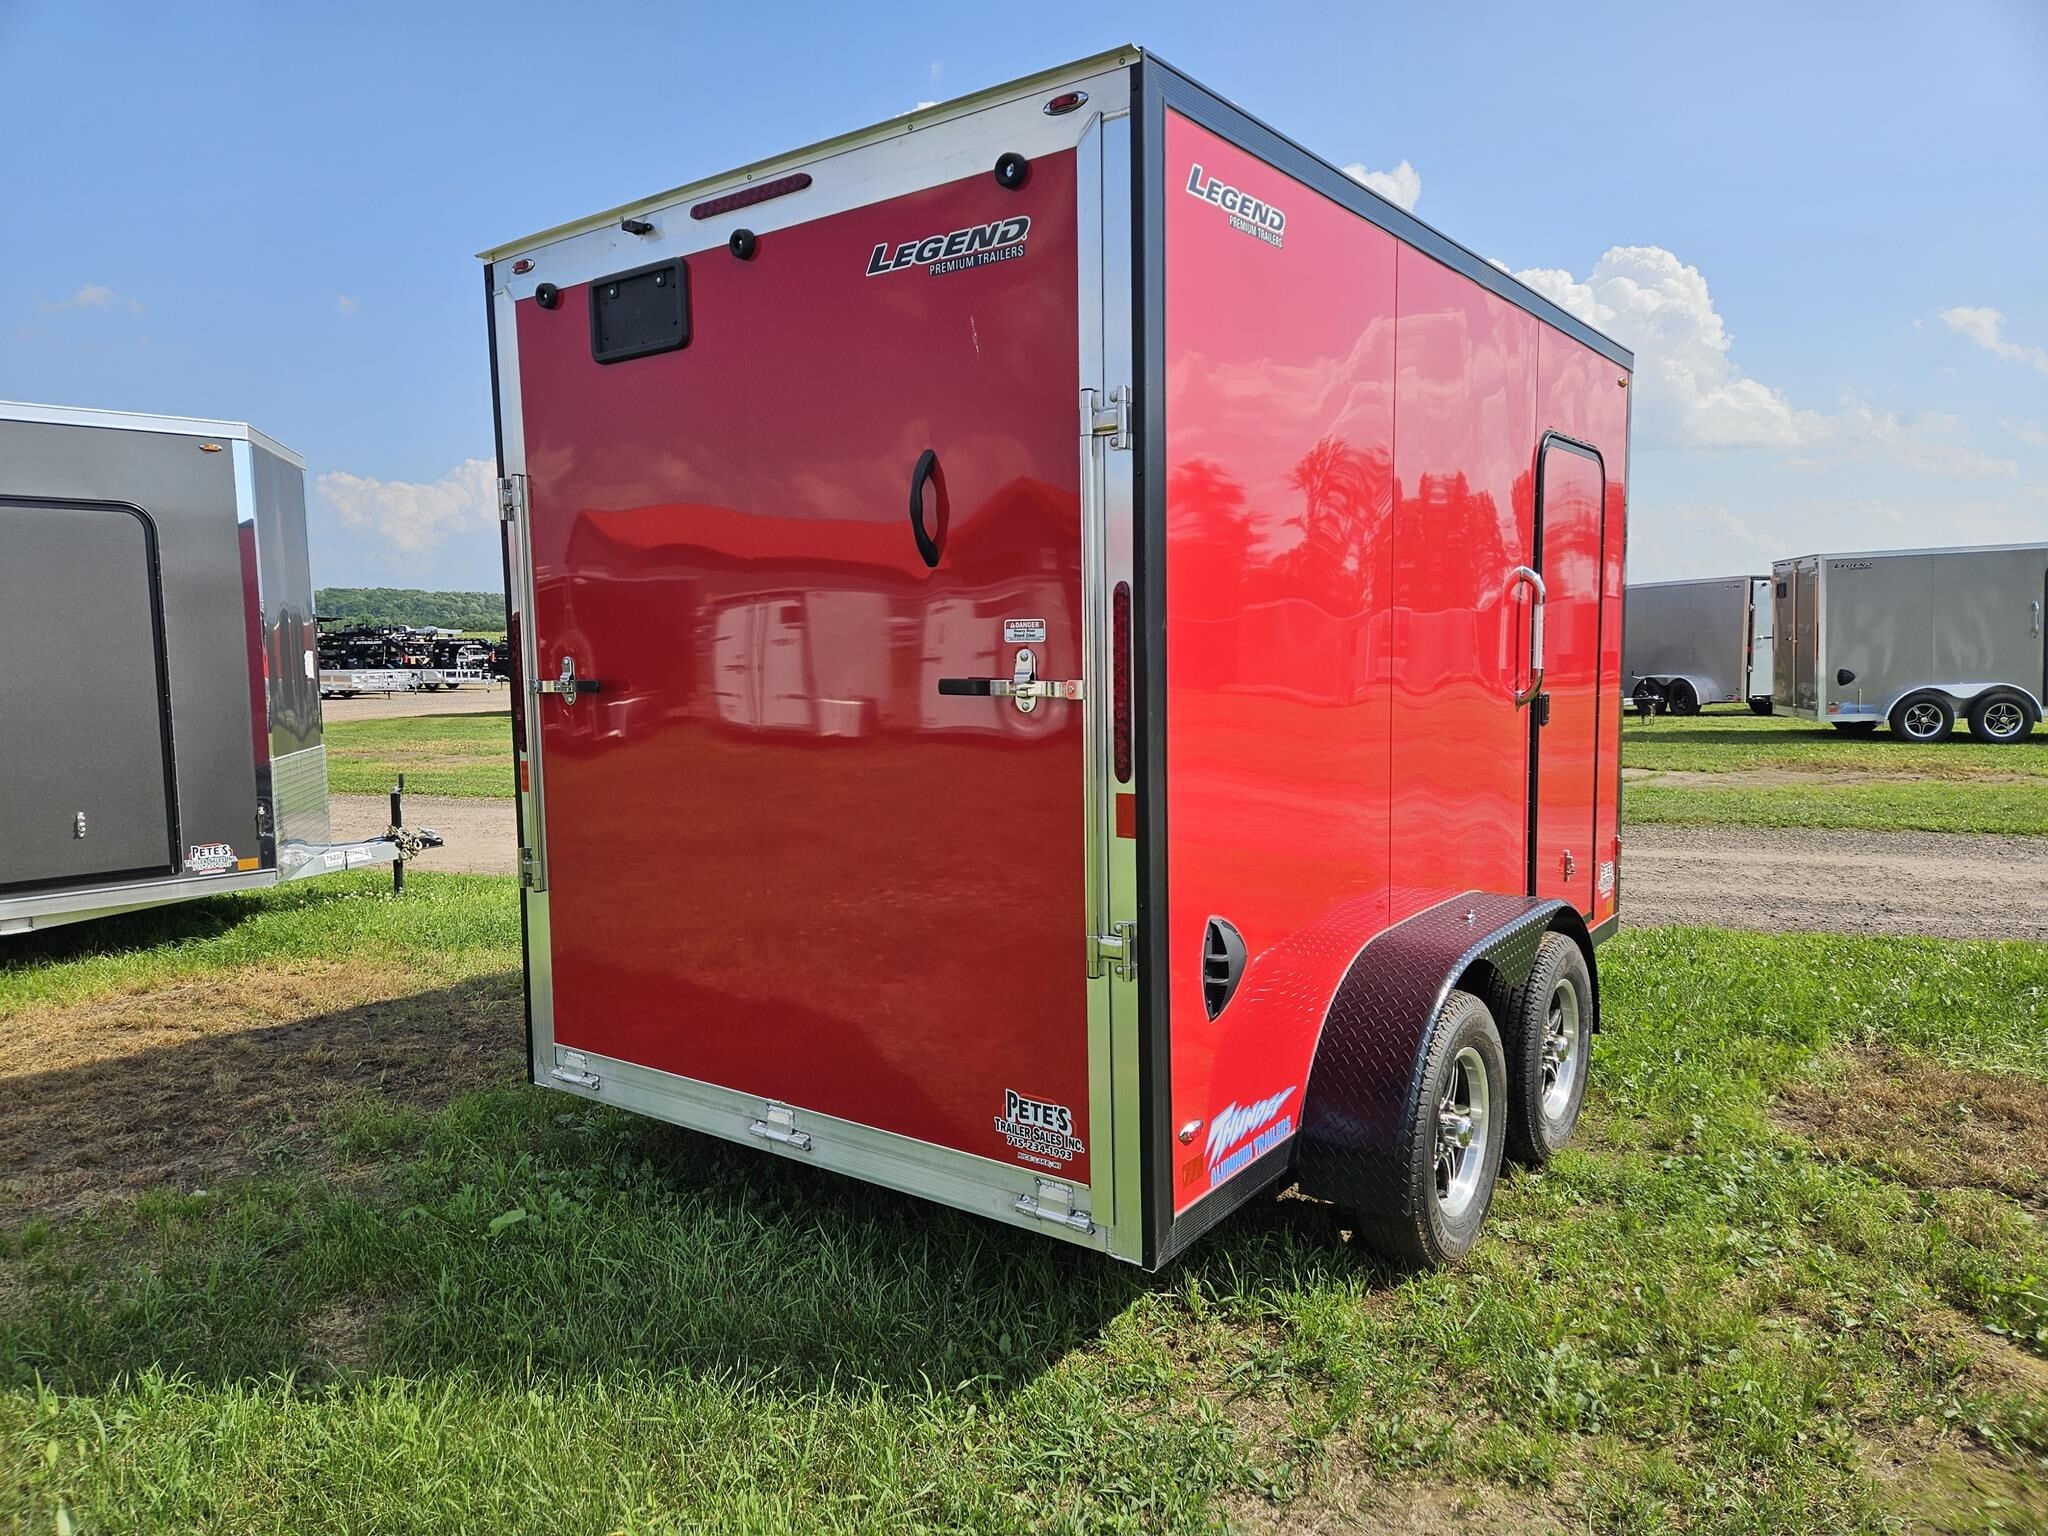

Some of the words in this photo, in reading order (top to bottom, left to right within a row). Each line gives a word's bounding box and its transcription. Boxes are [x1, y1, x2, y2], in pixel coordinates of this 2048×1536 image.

[1186, 163, 1285, 233] LEGEND
[866, 215, 1031, 276] LEGEND
[1229, 214, 1258, 236] PREMIUM
[1257, 227, 1283, 249] TRAILERS
[929, 254, 975, 276] PREMIUM
[978, 244, 1025, 265] TRAILERS
[192, 845, 228, 859] PETE'S
[1006, 1088, 1071, 1133] PETE'S
[994, 1117, 1031, 1140] TRAILER
[1033, 1127, 1062, 1148] SALES
[1064, 1135, 1085, 1153] INC.
[1007, 1136, 1072, 1161] 715-234-1993
[1211, 1142, 1253, 1187] ALUMINUM
[1253, 1115, 1292, 1156] TRAILERS
